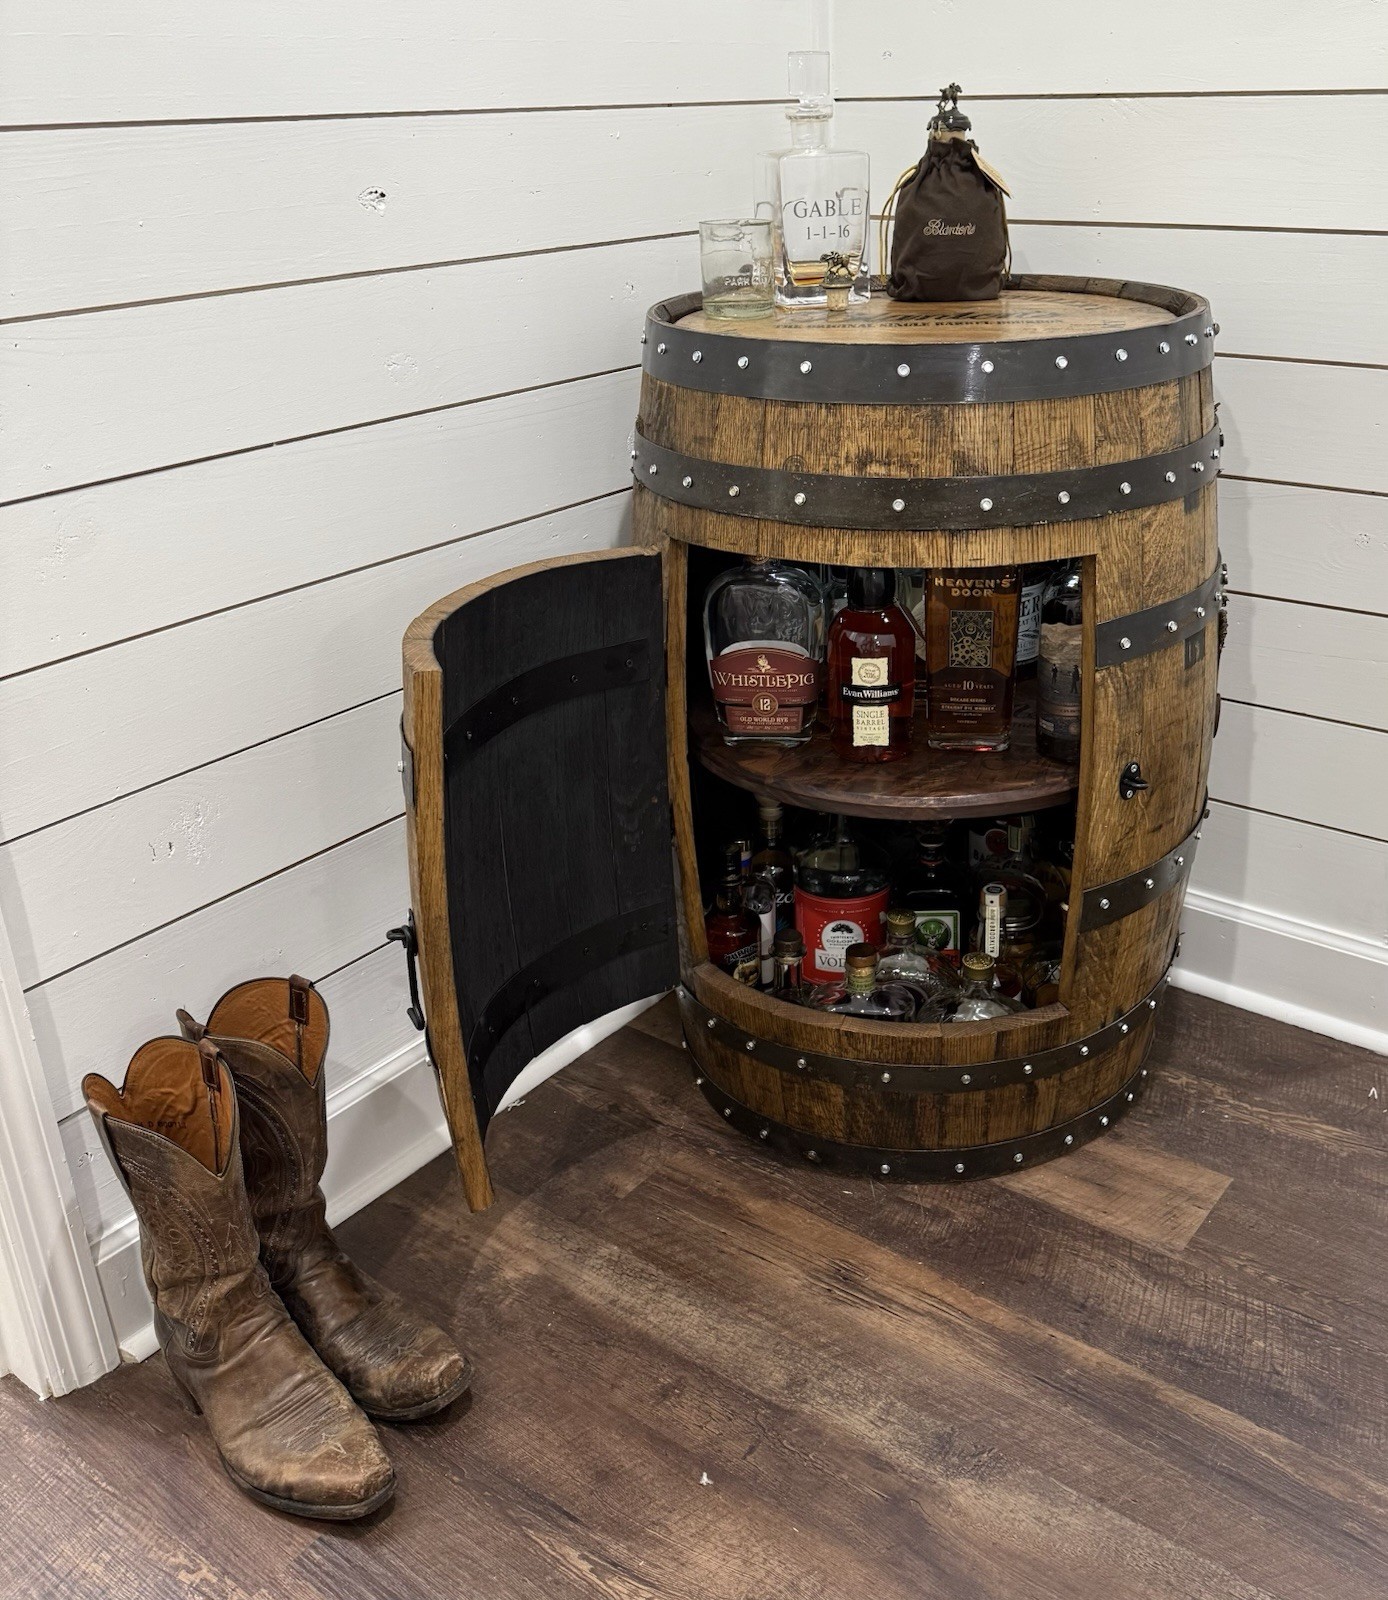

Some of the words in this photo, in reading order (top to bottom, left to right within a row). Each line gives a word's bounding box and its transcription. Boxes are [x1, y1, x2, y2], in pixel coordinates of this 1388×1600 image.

[793, 198, 862, 218] GABLE
[807, 224, 850, 240] 1-1-16
[934, 577, 1012, 588] HEAVEN'S
[950, 588, 994, 597] DOOR
[712, 669, 815, 690] WHISTLEPIG
[963, 680, 975, 691] 10
[842, 686, 862, 698] Evan
[862, 688, 898, 699] Williams
[760, 698, 771, 711] 12
[856, 710, 885, 718] SINGLE
[818, 955, 847, 968] VOD
